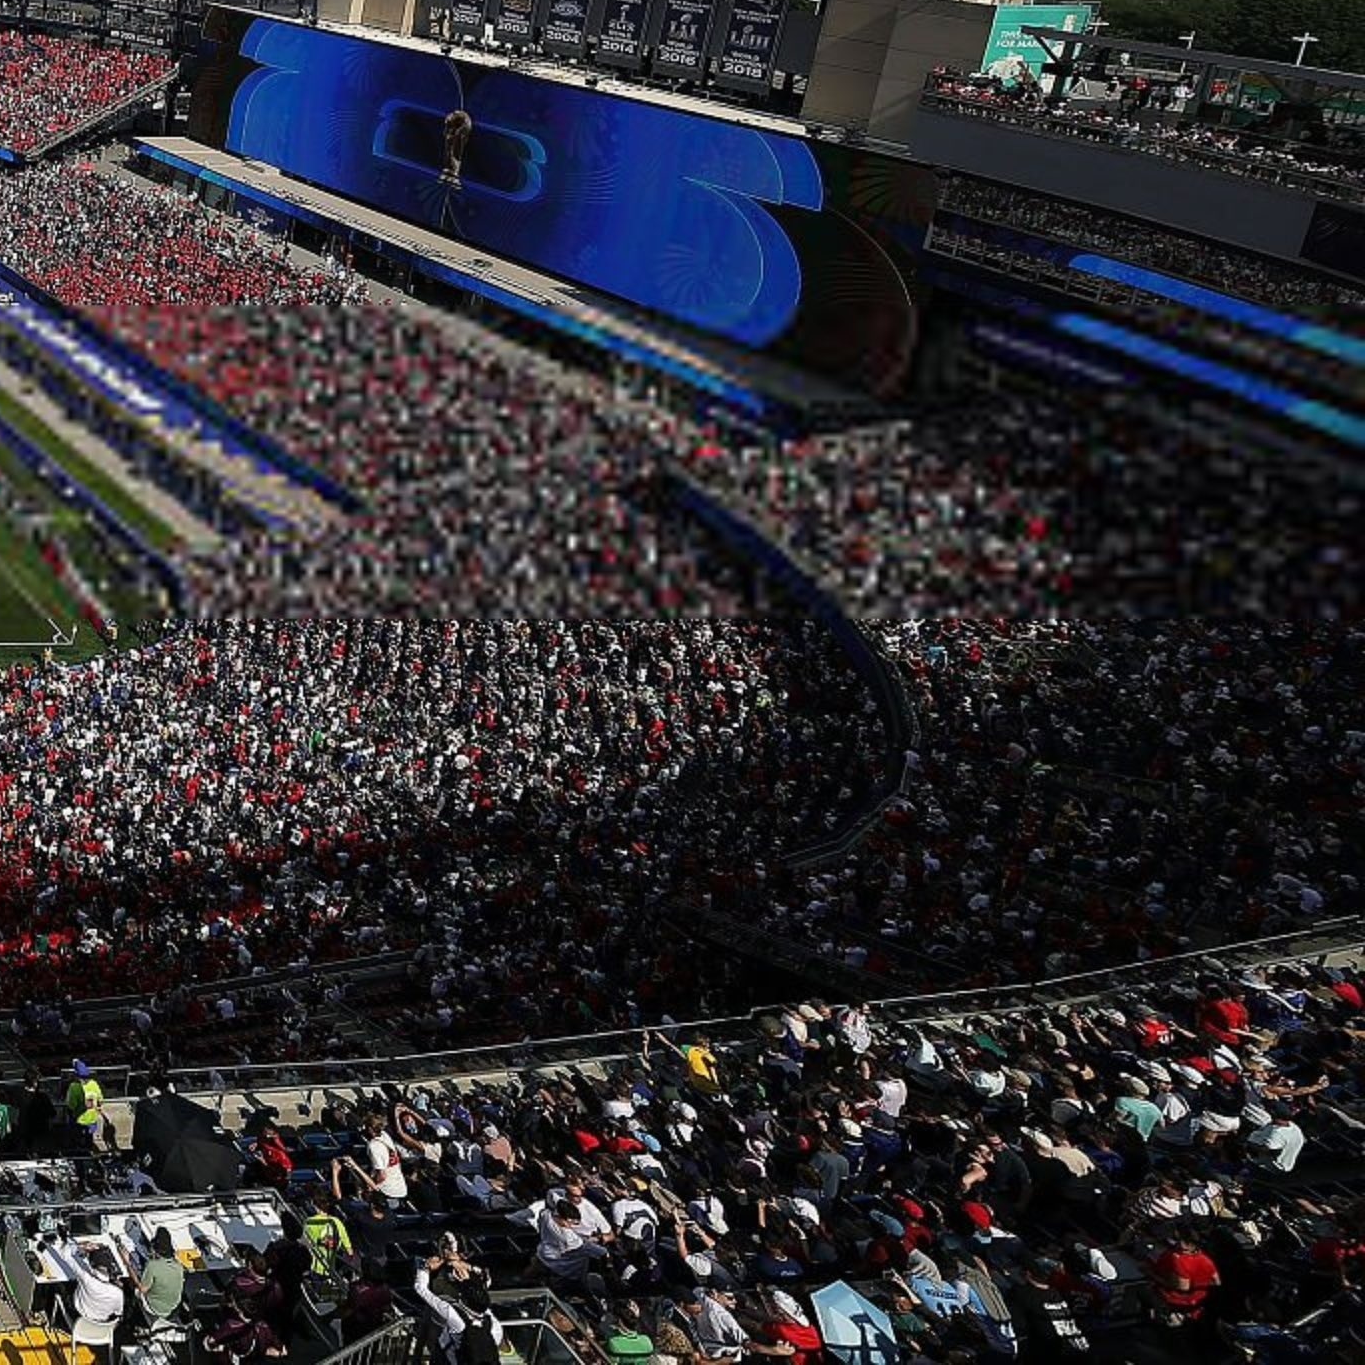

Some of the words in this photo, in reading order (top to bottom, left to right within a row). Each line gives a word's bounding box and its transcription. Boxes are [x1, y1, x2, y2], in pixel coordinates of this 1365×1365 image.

[601, 40, 635, 54] 2014
[660, 50, 696, 66] 2016
[722, 62, 762, 78] 2018
